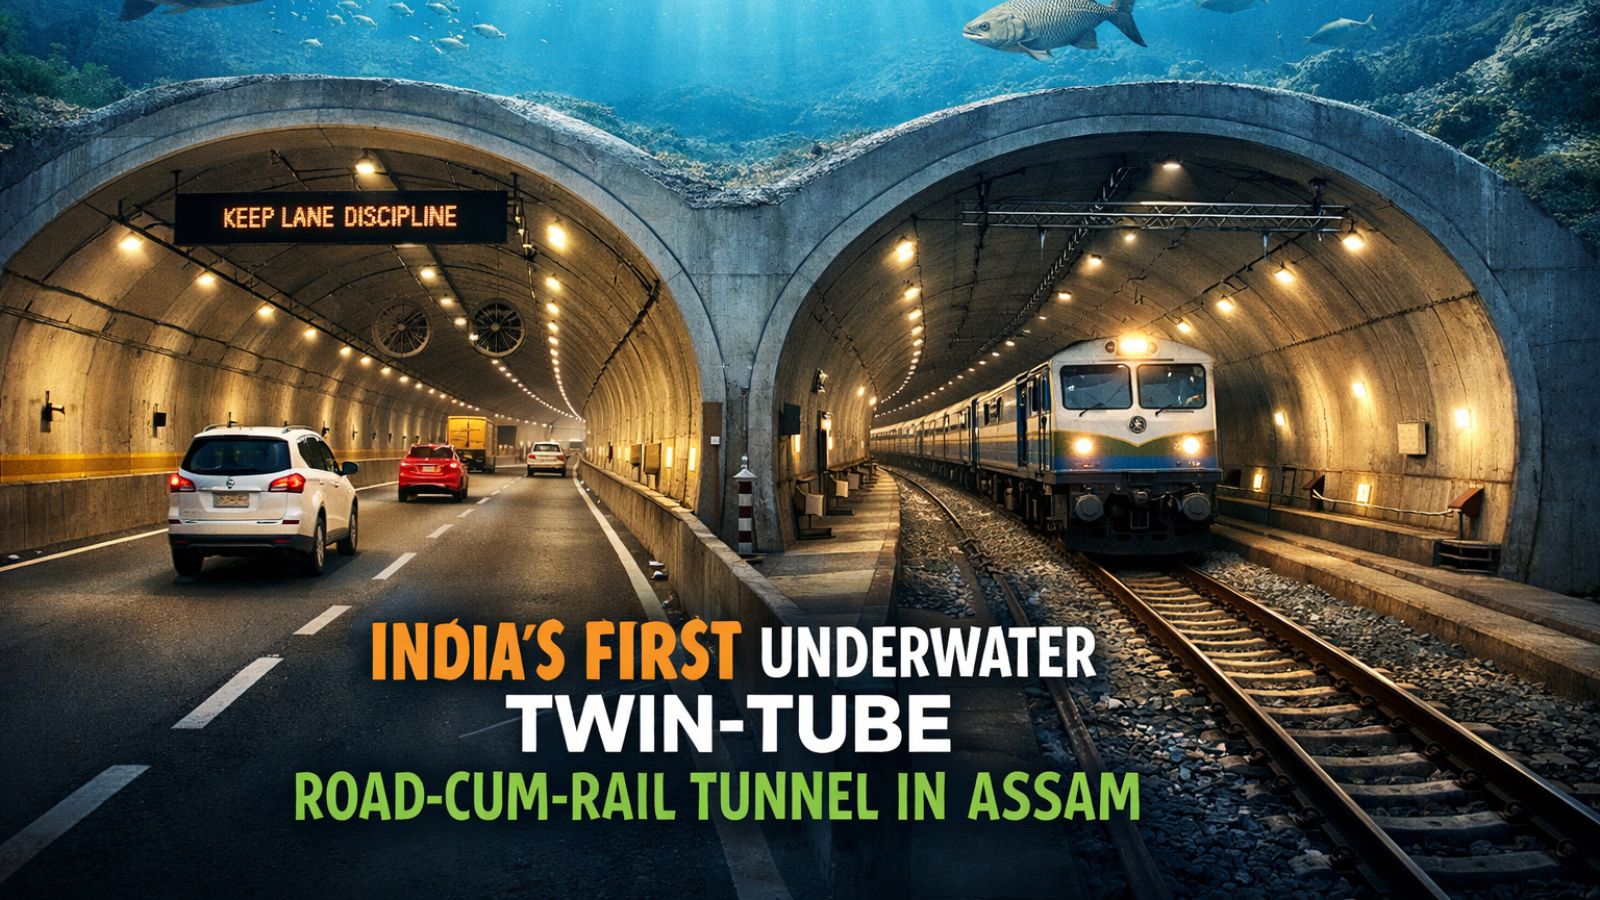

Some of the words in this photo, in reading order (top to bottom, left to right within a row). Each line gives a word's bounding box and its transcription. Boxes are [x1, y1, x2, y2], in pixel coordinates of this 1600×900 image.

[223, 207, 275, 229] KEEP
[281, 205, 334, 228] LANE
[344, 205, 457, 227] DISCIPLINE
